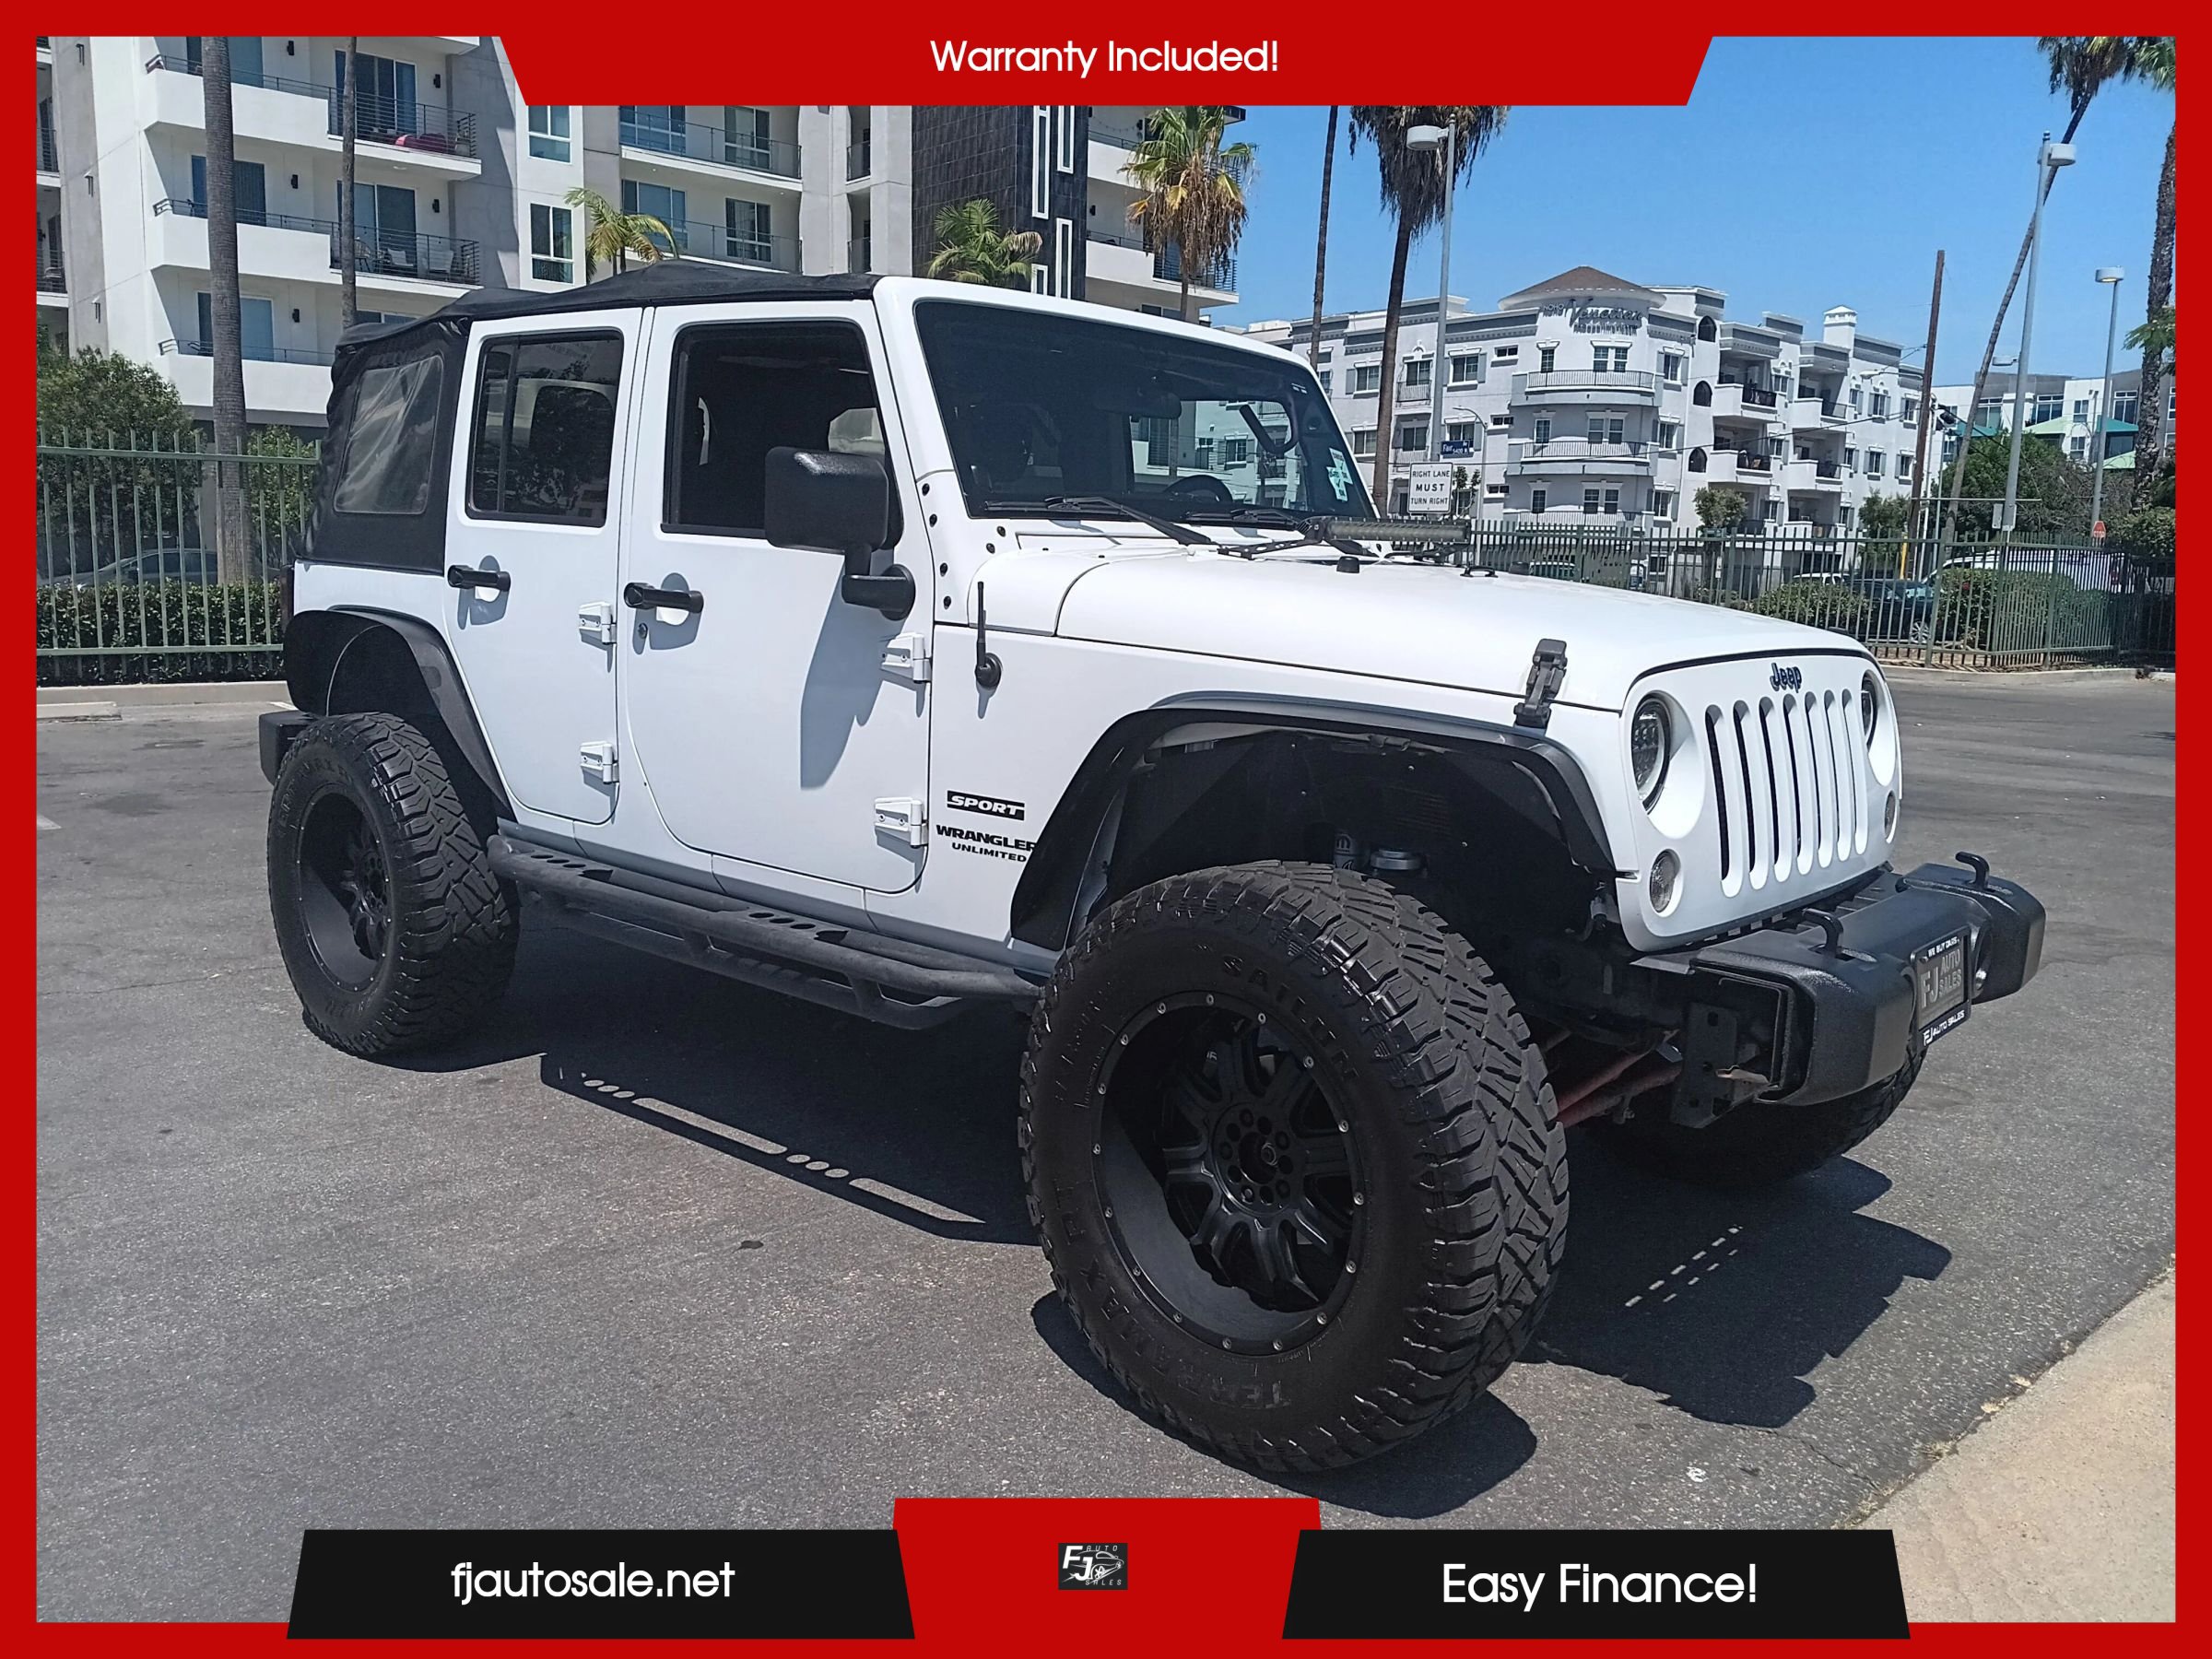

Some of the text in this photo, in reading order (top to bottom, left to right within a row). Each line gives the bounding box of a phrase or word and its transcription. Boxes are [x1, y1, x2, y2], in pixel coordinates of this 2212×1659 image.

[1412, 470, 1430, 478] RIGHT
[1416, 483, 1444, 492] MUST
[1411, 497, 1448, 505] TURN RIGHT
[1770, 663, 1802, 693] Jeep
[947, 794, 1026, 816] SPORT
[951, 841, 1027, 863] UNLIMITED
[1941, 948, 1960, 975] AUTO
[1921, 966, 1939, 1009] FJ
[1939, 969, 1962, 995] SALES
[1947, 1009, 1965, 1026] SALES
